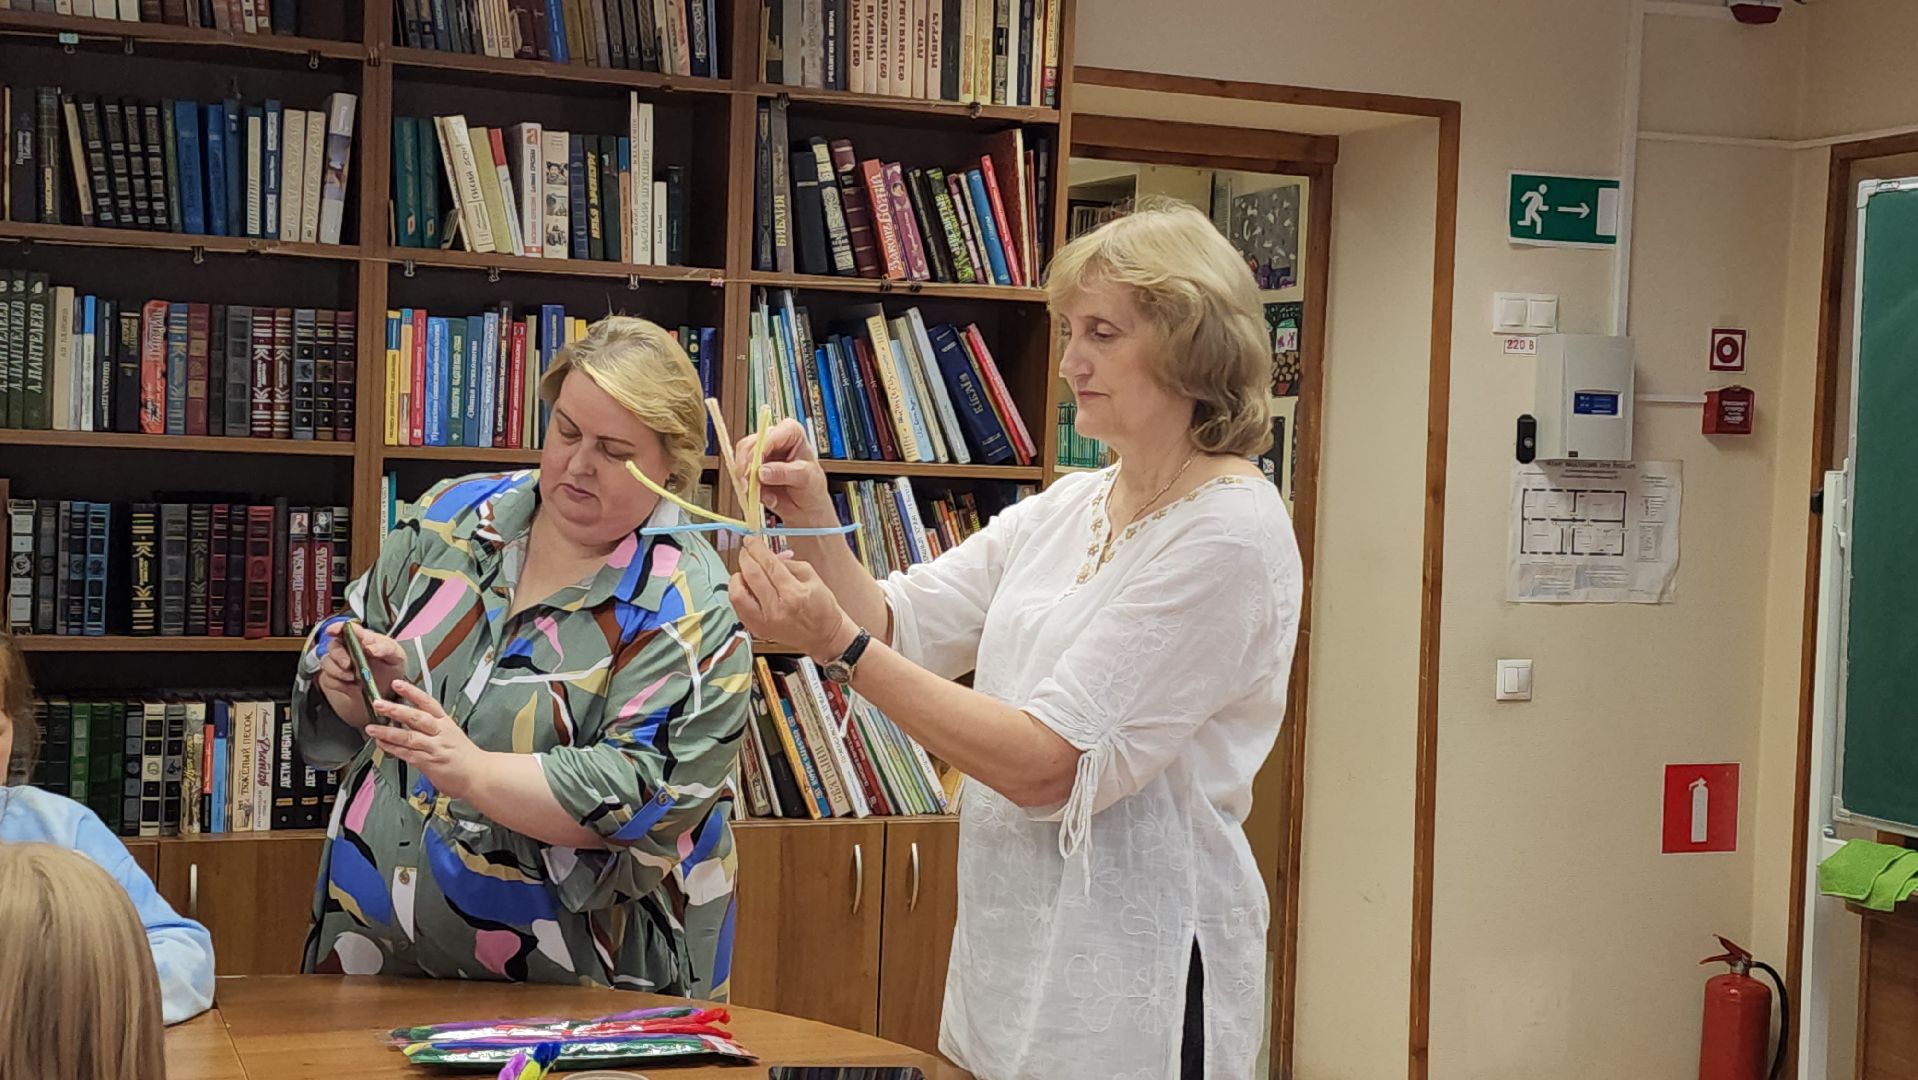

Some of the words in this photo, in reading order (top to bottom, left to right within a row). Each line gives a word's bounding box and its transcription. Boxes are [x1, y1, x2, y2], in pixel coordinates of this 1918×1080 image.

[852, 0, 860, 67] ЗЫЧЕСТВО
[774, 194, 787, 247] БИБЛИЯ
[10, 300, 24, 379] ПАНТЕЛЕЕВ
[28, 303, 44, 381] ПАНТЕЛЕЕВ
[1507, 339, 1525, 350] 220
[280, 721, 292, 760] АРБАТА
[280, 762, 292, 788] ДЕТИ
[305, 766, 316, 787] ДЕТ
